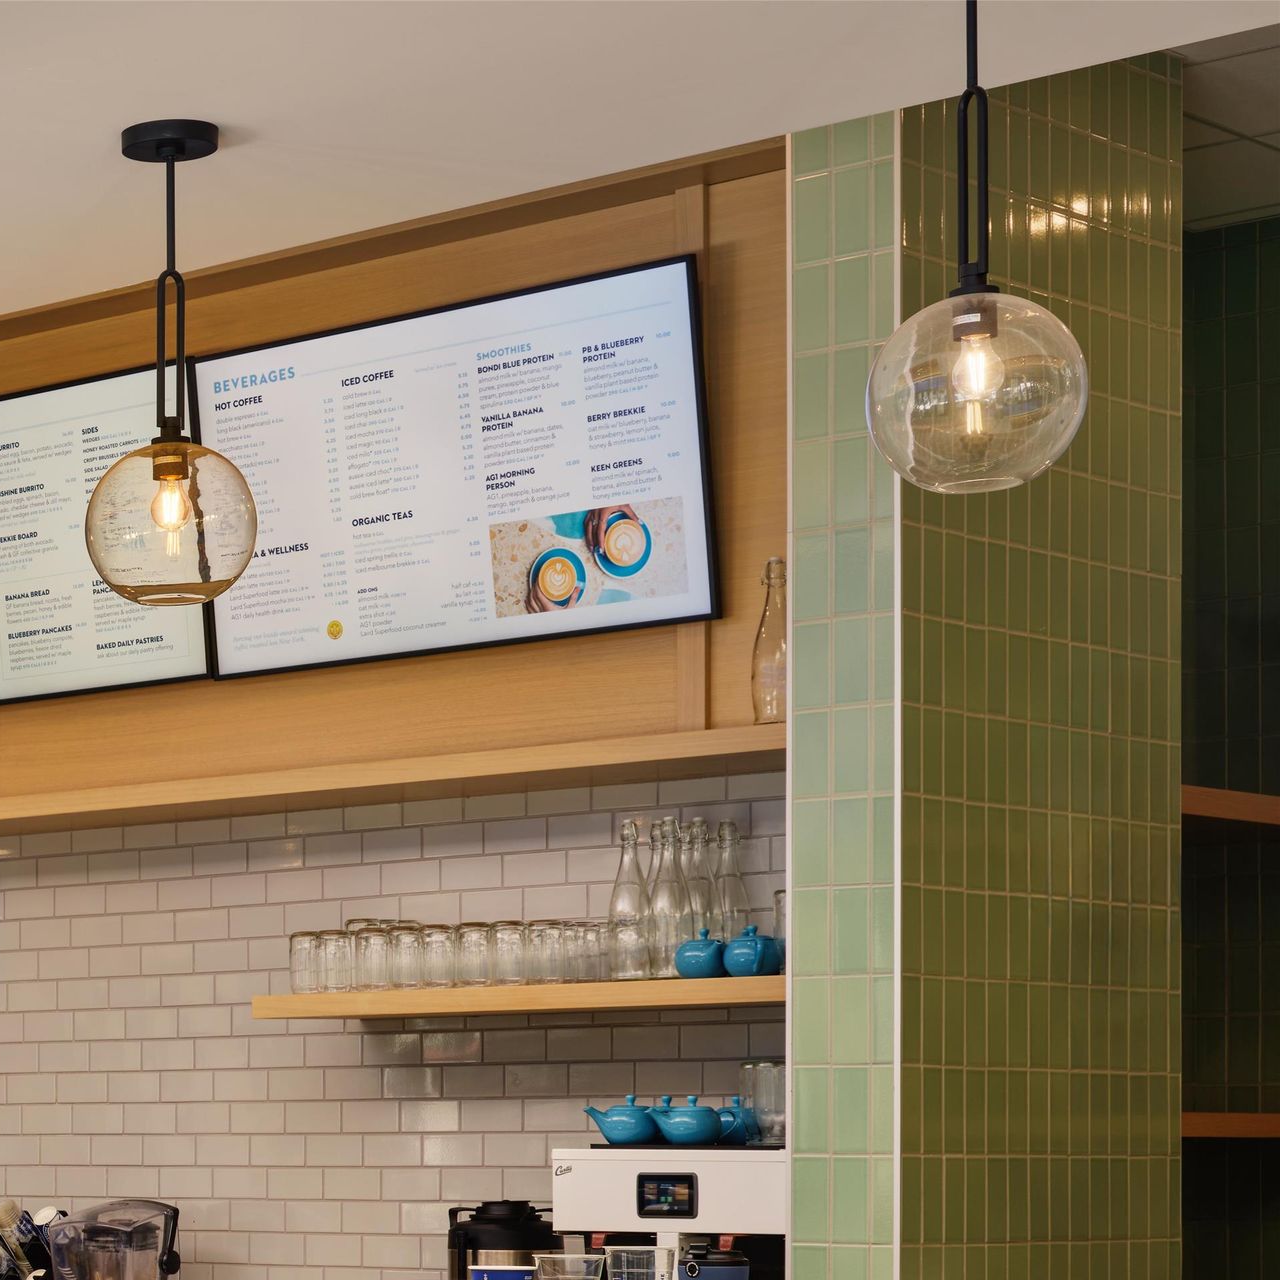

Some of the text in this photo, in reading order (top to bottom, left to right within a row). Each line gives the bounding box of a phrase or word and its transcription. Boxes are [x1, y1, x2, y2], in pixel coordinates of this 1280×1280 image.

[476, 343, 532, 361] SMOOTHIES
[582, 345, 592, 354] PB
[601, 335, 644, 350] BLUEBERRY
[477, 353, 555, 374] BONDI BLUE PROTEIN
[583, 351, 616, 363] PROTEIN
[214, 366, 295, 394] BEVERAGES
[341, 369, 394, 387] ICED COFFEE
[215, 395, 263, 411] HOT COFFEE
[481, 406, 544, 422] VANILLA BANANA
[587, 406, 647, 423] BERRY BREKKIE
[82, 426, 99, 436] SIDES
[482, 421, 513, 432] PROTEIN
[99, 442, 119, 451] ROASTED
[94, 464, 109, 472] SALAD
[591, 458, 643, 472] KEEN GREENS
[500, 467, 535, 480] MORNING
[19, 483, 45, 494] BURRITO
[486, 480, 516, 491] PERSON
[351, 509, 414, 527] ORGANIC TEAS
[17, 531, 38, 541] BOARD
[260, 542, 309, 557] & WELLNESS
[5, 588, 50, 601] BANANA BREAD
[7, 624, 73, 641] BLUEBERRY PANCAKES
[96, 635, 164, 651] BAKED DAILY PASTRIES
